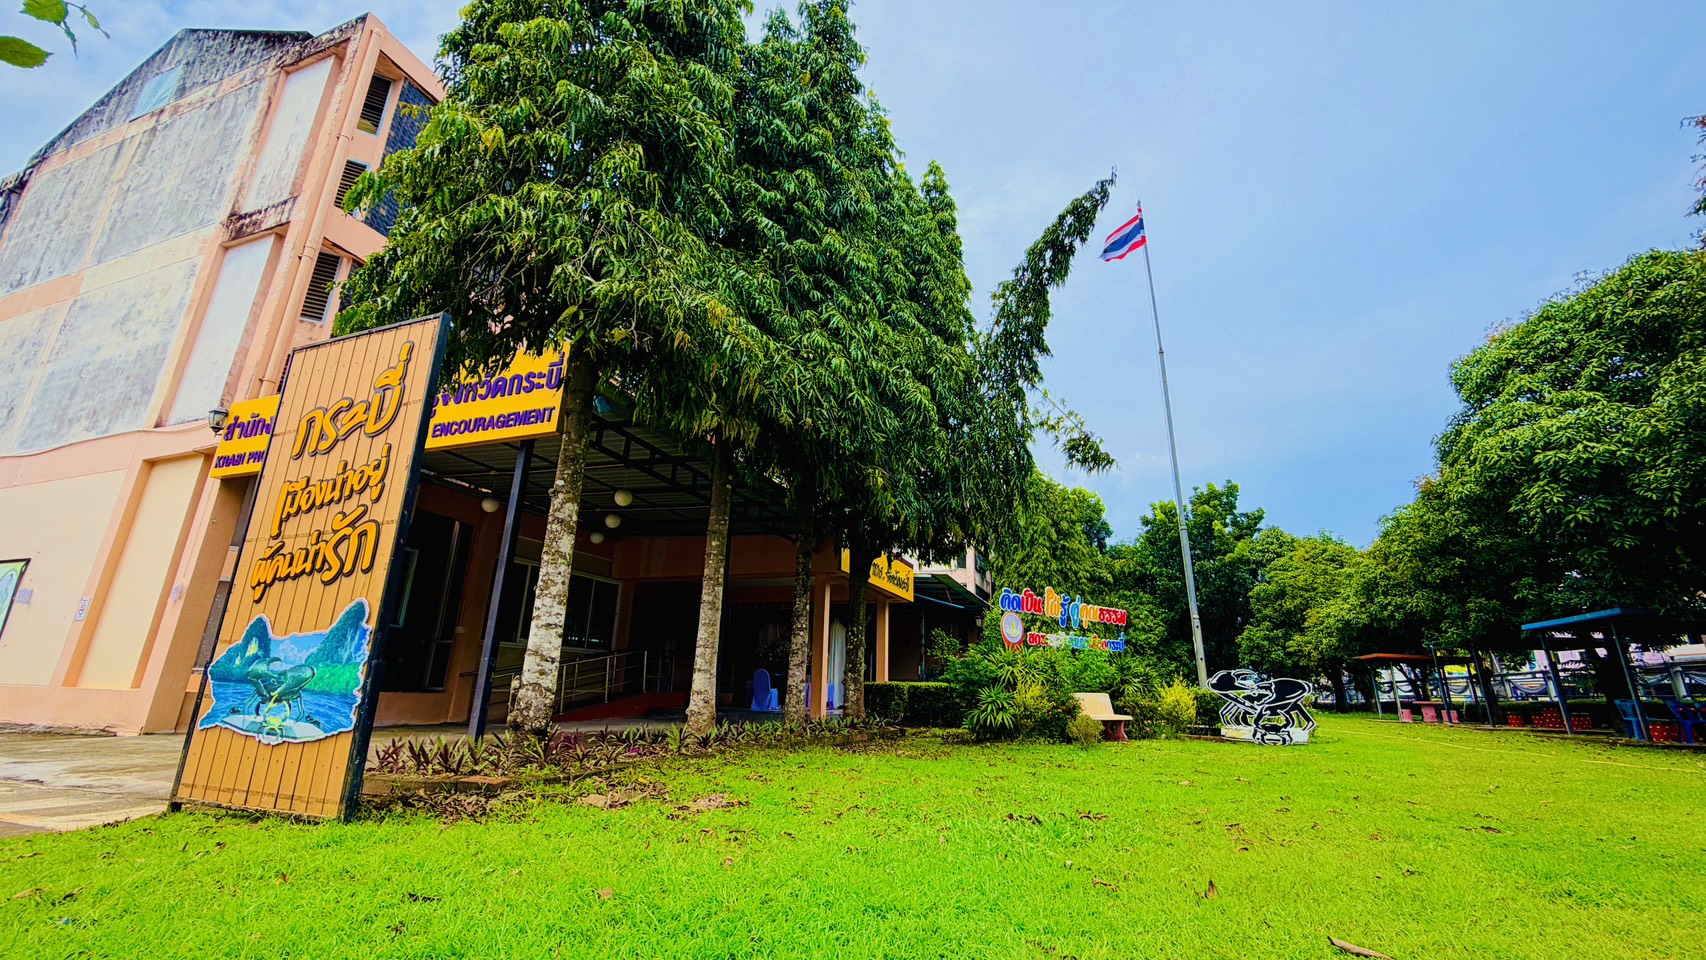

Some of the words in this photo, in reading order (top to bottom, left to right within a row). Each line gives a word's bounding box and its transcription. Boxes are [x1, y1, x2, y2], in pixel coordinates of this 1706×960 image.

[214, 451, 246, 469] KRABI
[431, 406, 556, 438] ENCOURAGEMENT
[292, 341, 414, 460] กระบี่
[271, 443, 391, 539] เมืองน่าอยู่
[250, 505, 380, 604] ผู้คนน่ารัก
